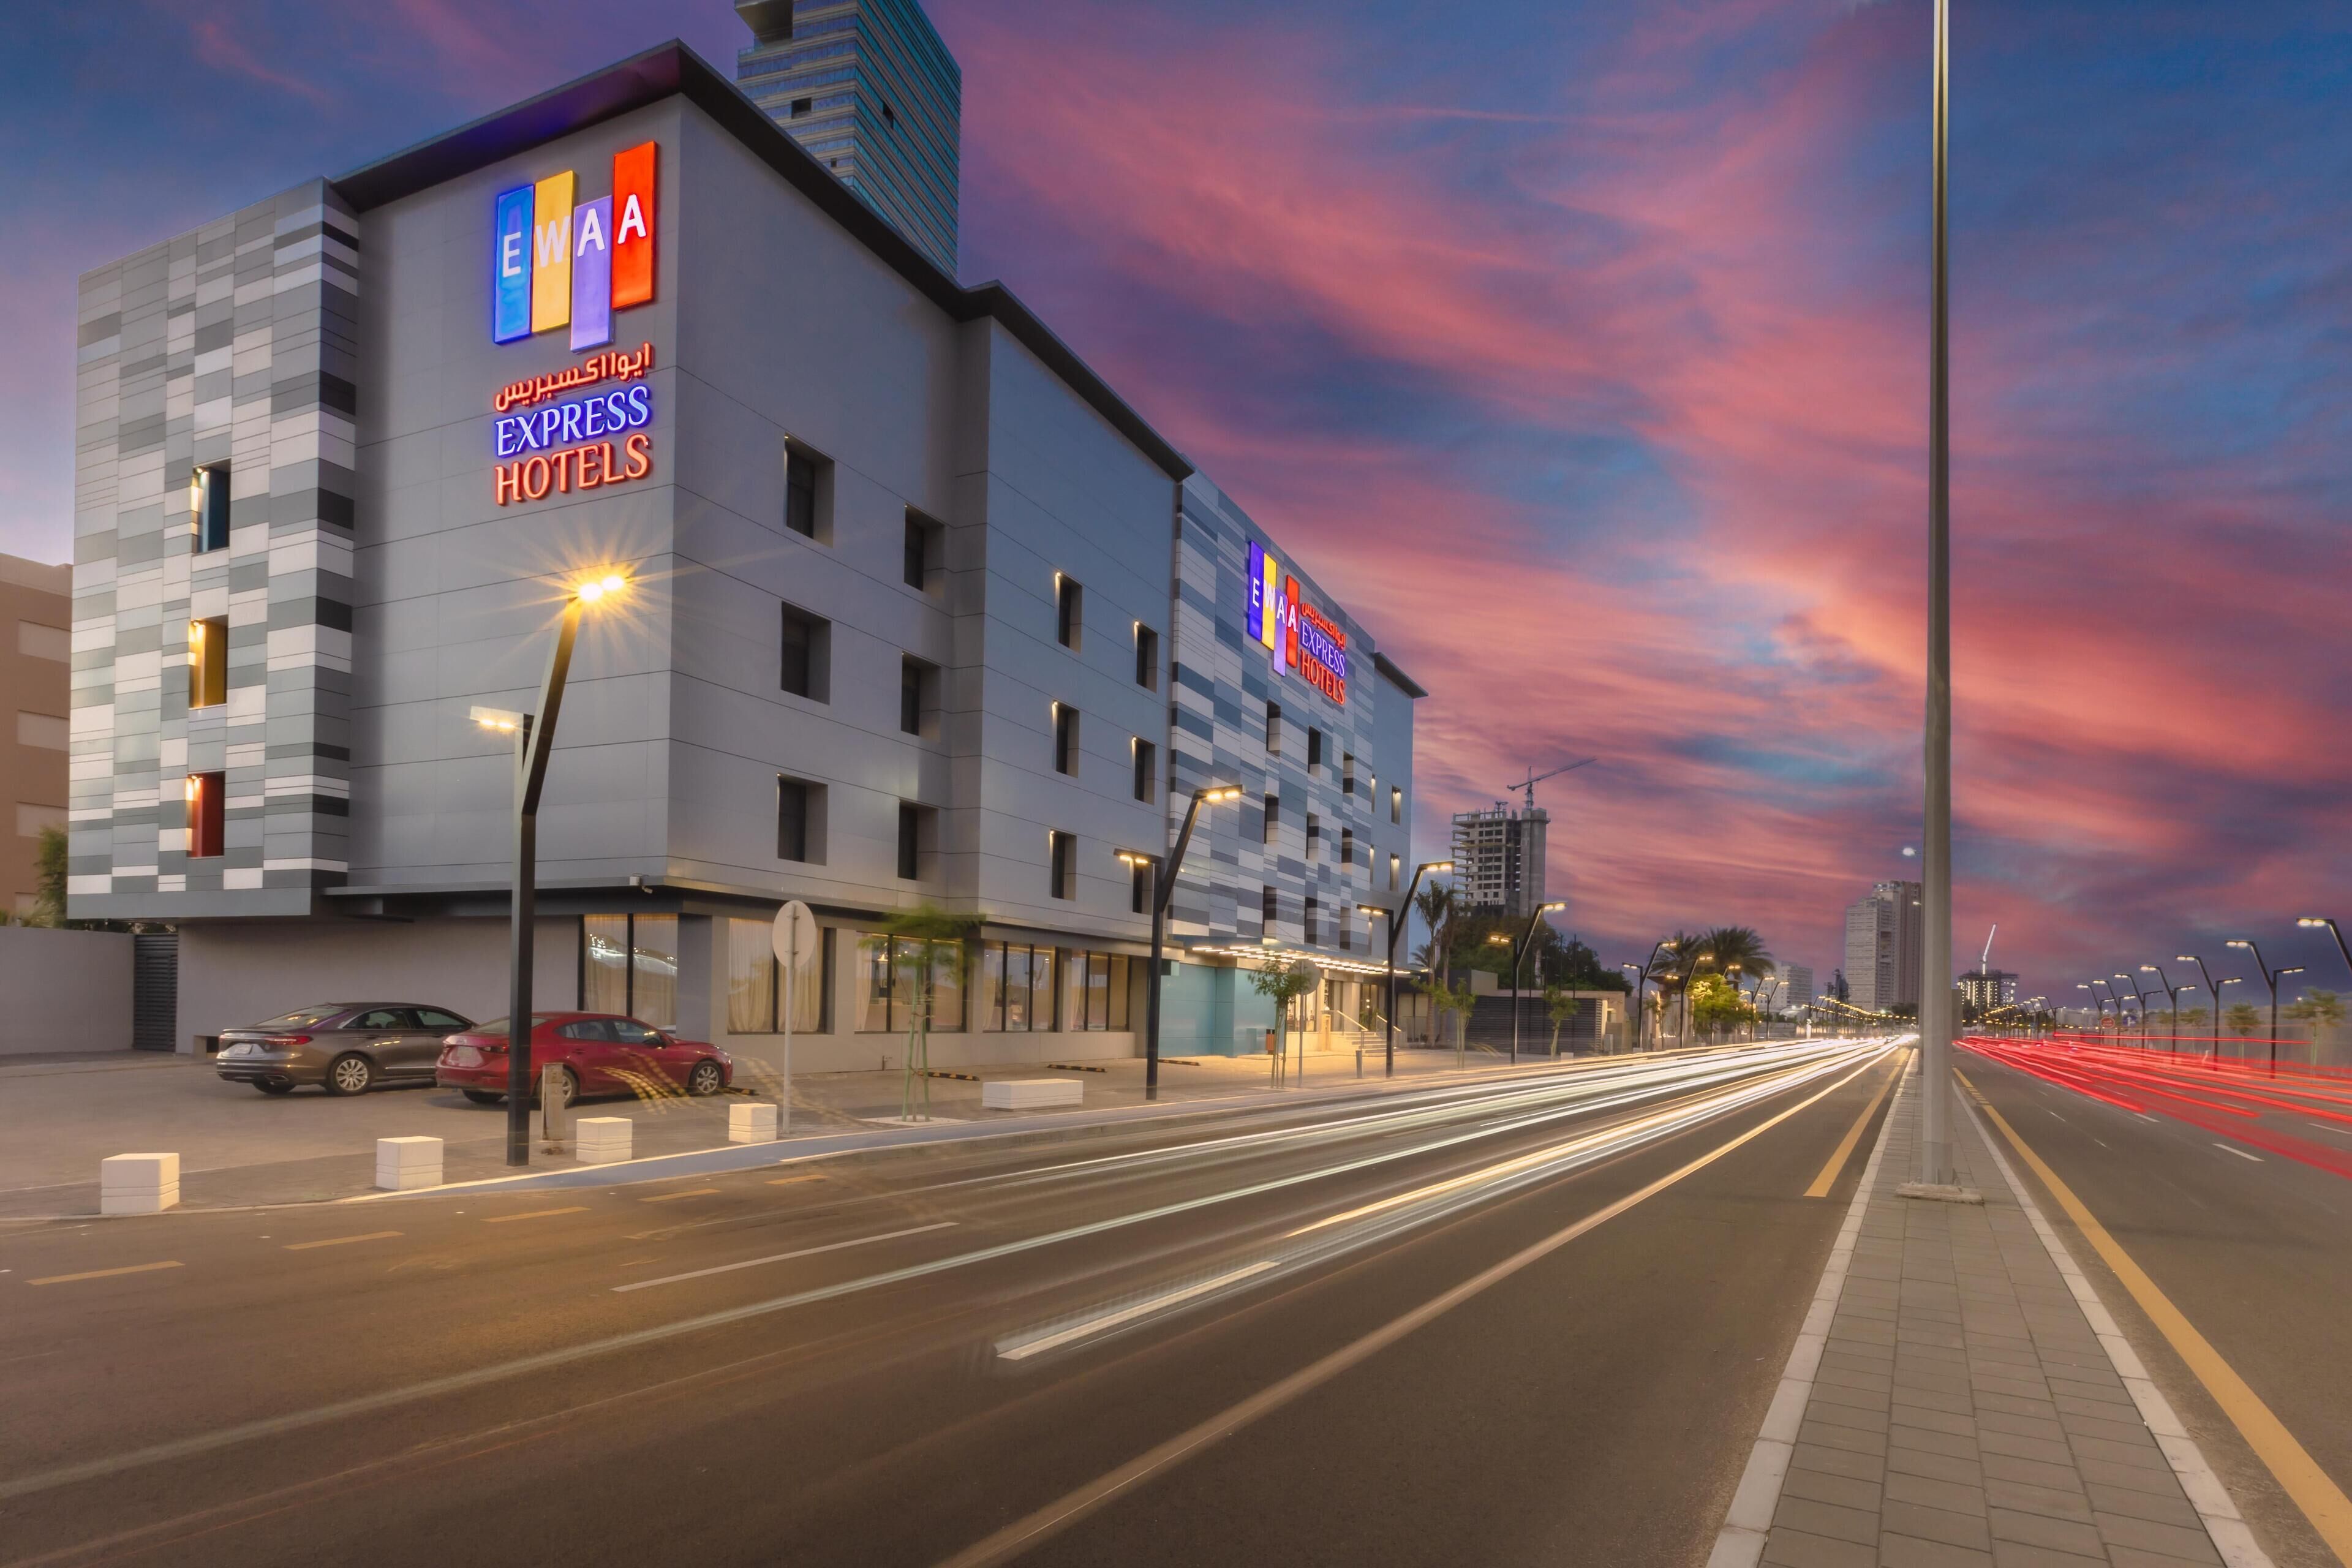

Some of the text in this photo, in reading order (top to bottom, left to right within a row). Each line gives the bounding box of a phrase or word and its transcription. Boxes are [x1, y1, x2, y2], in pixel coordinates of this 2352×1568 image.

[503, 194, 646, 278] EWAA
[496, 386, 649, 456] EXPRESS
[495, 434, 650, 505] HOTELS
[1253, 577, 1298, 632] EWAA
[1301, 649, 1345, 704] HOTELS
[1302, 620, 1345, 677] EXPRESS
